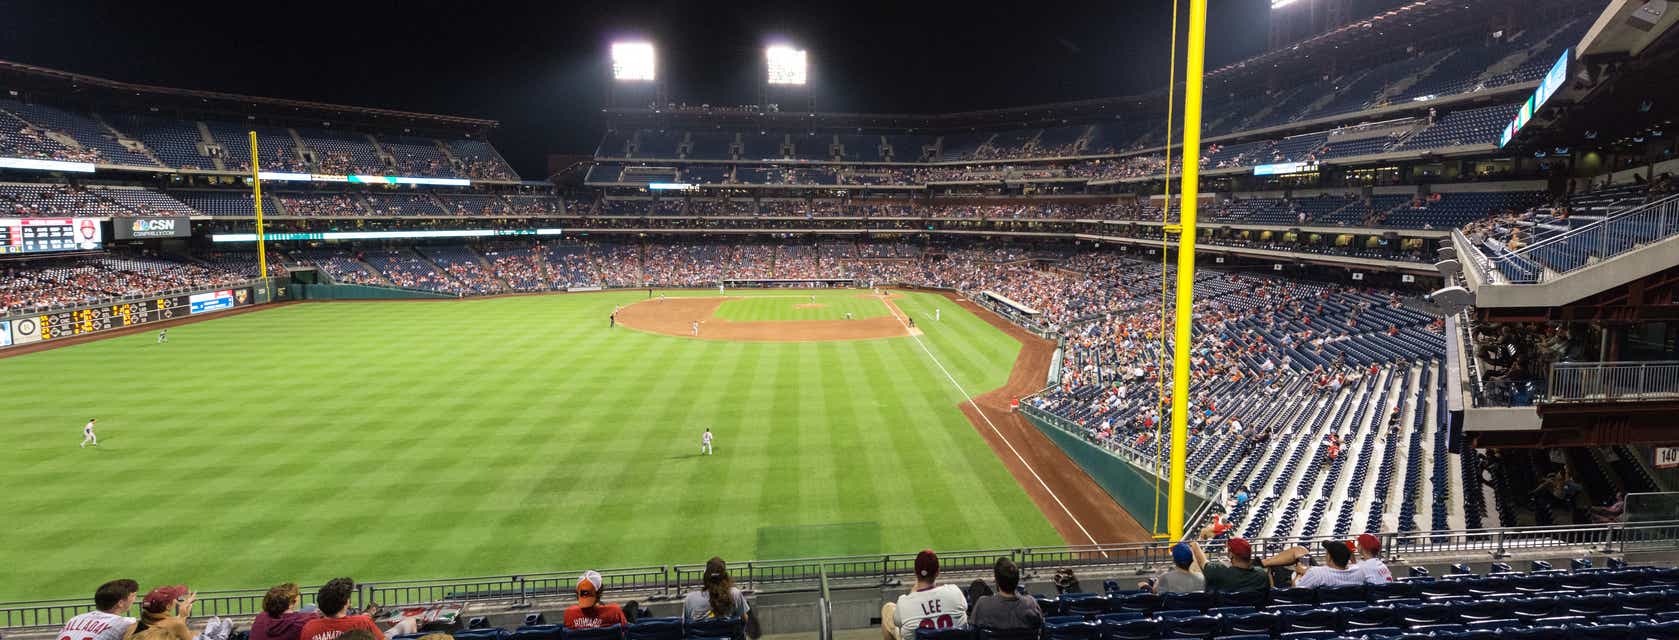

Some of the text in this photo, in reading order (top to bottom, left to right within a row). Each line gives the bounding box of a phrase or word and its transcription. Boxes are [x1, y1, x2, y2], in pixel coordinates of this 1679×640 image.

[149, 219, 175, 230] CSN
[1662, 448, 1677, 463] 140
[921, 599, 942, 616] LEE
